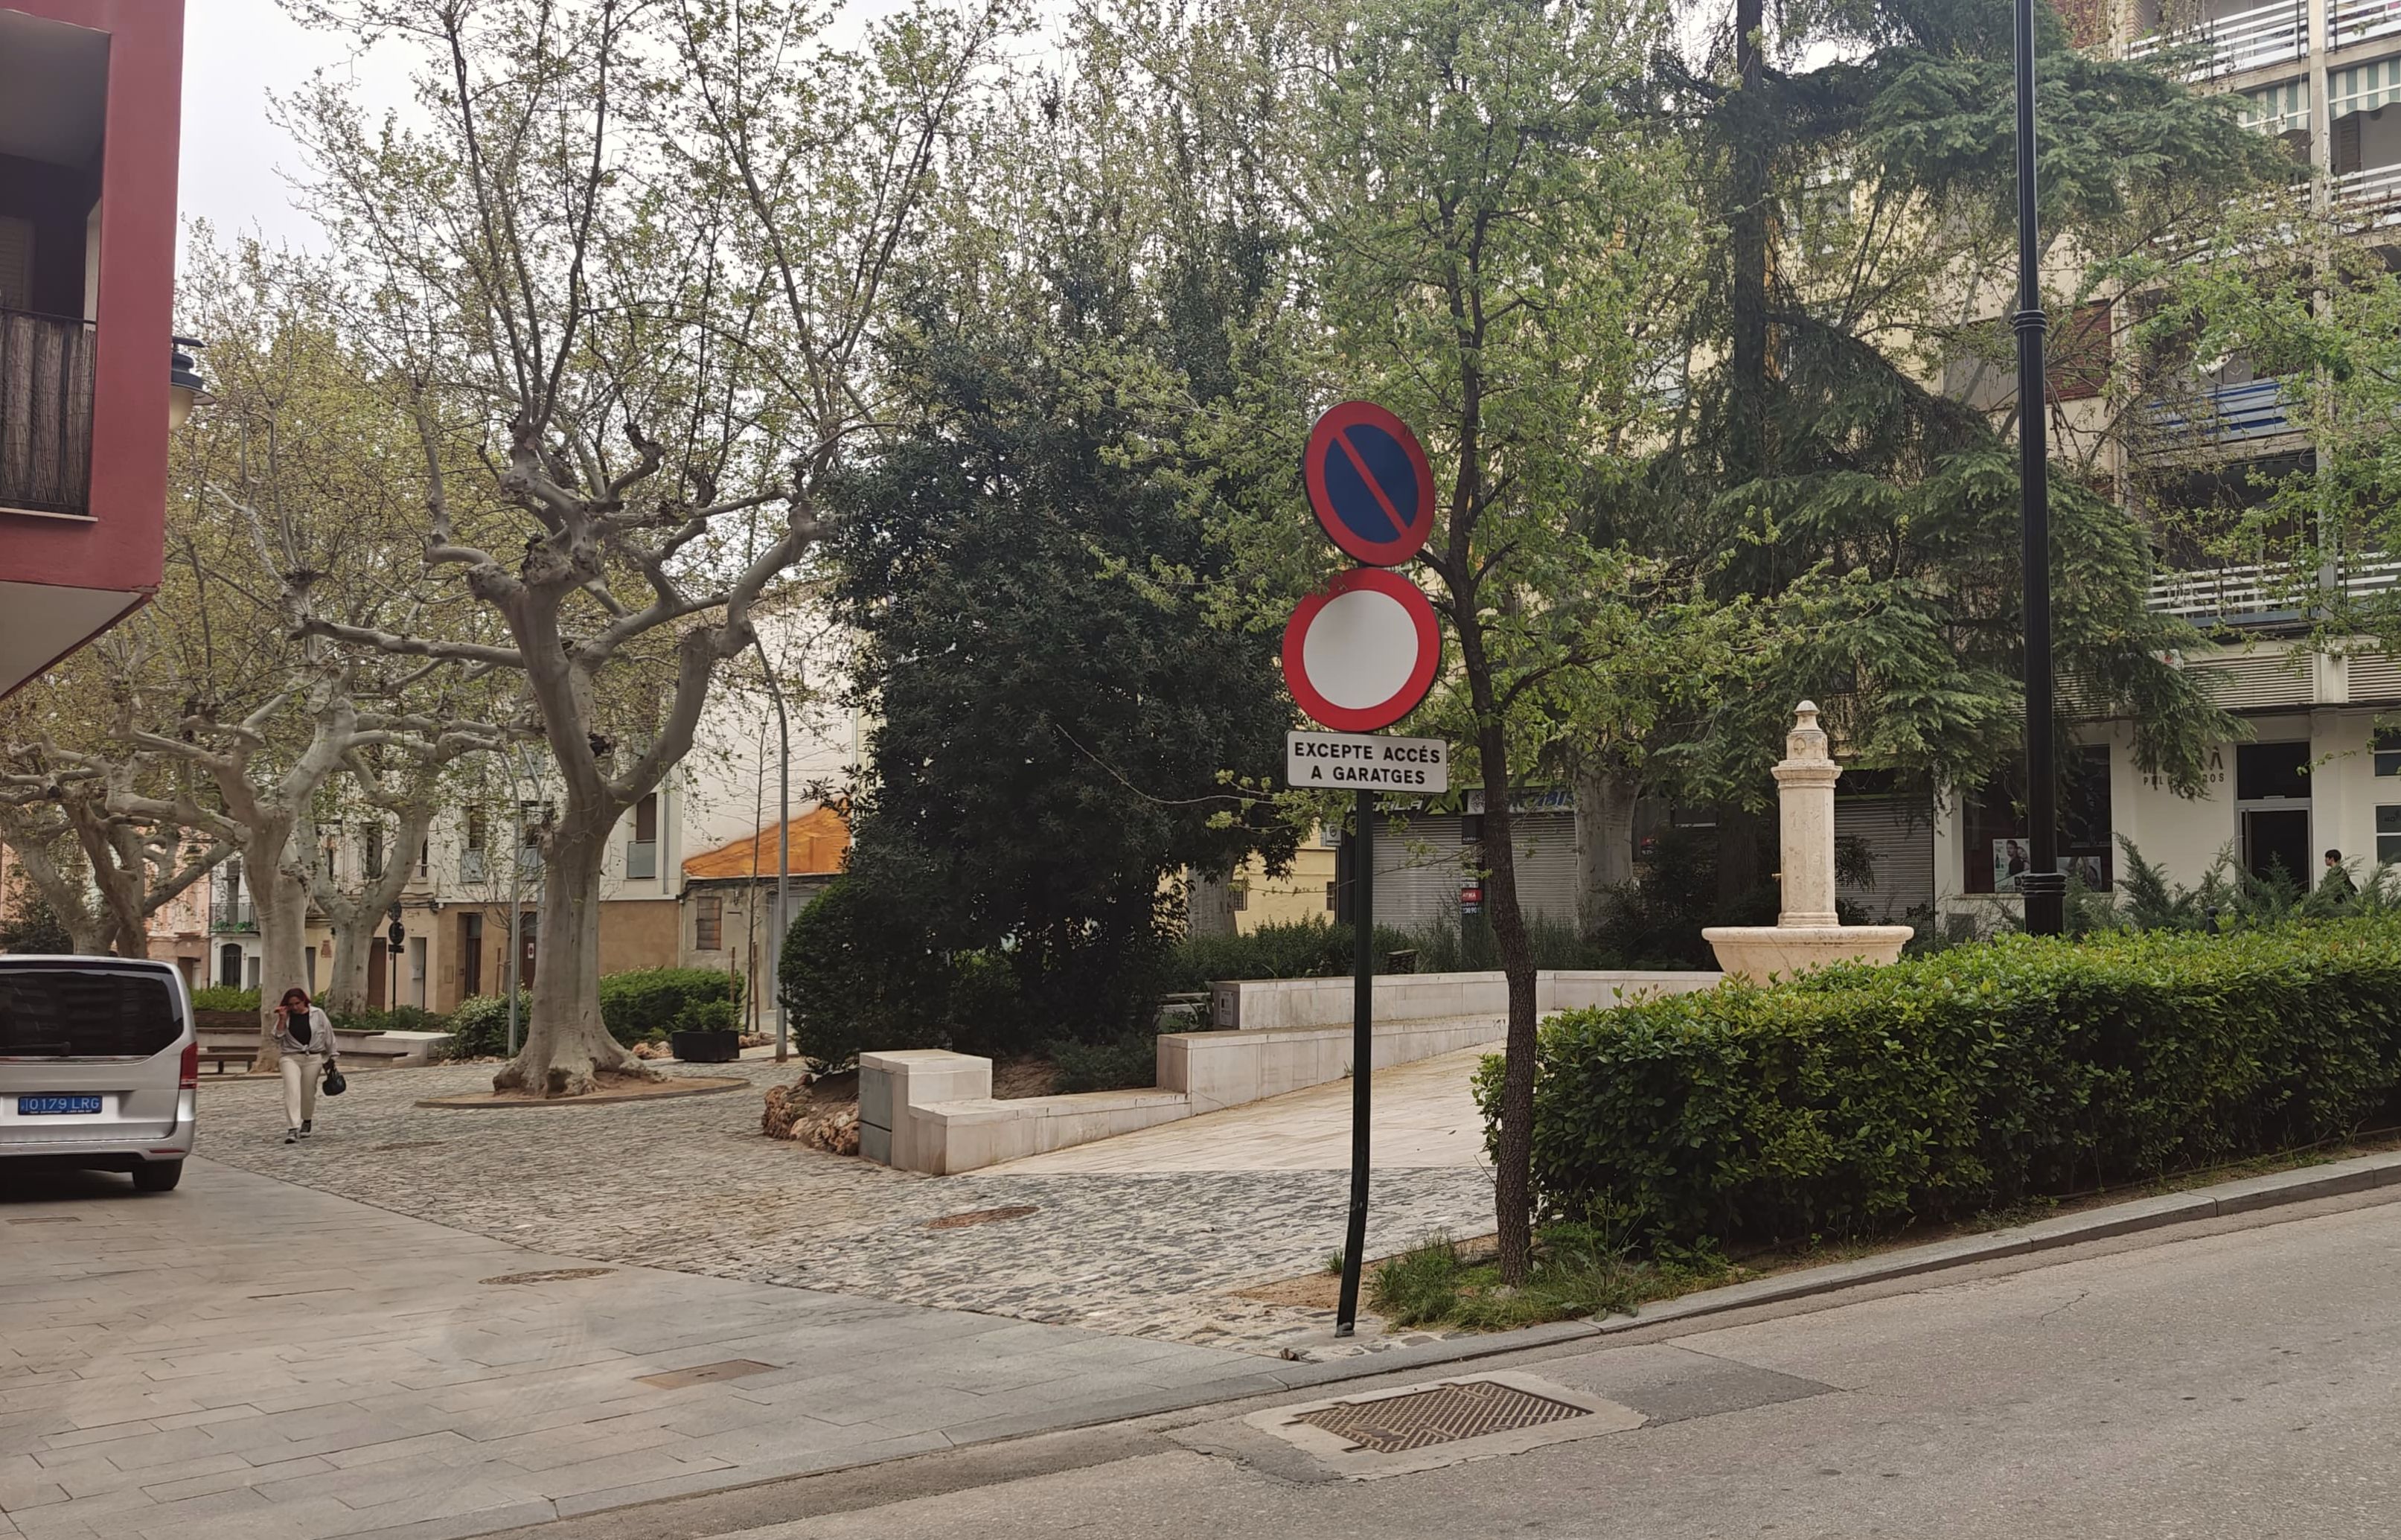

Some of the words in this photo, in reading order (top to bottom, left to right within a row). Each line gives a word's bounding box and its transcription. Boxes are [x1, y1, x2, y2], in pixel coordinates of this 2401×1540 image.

[1294, 742, 1373, 760] EXCEPTE
[1383, 745, 1440, 764] ACCÉS
[1311, 765, 1323, 779] A
[1333, 767, 1425, 785] GARATGES
[30, 1098, 67, 1110] 0179
[71, 1097, 100, 1109] LRG
